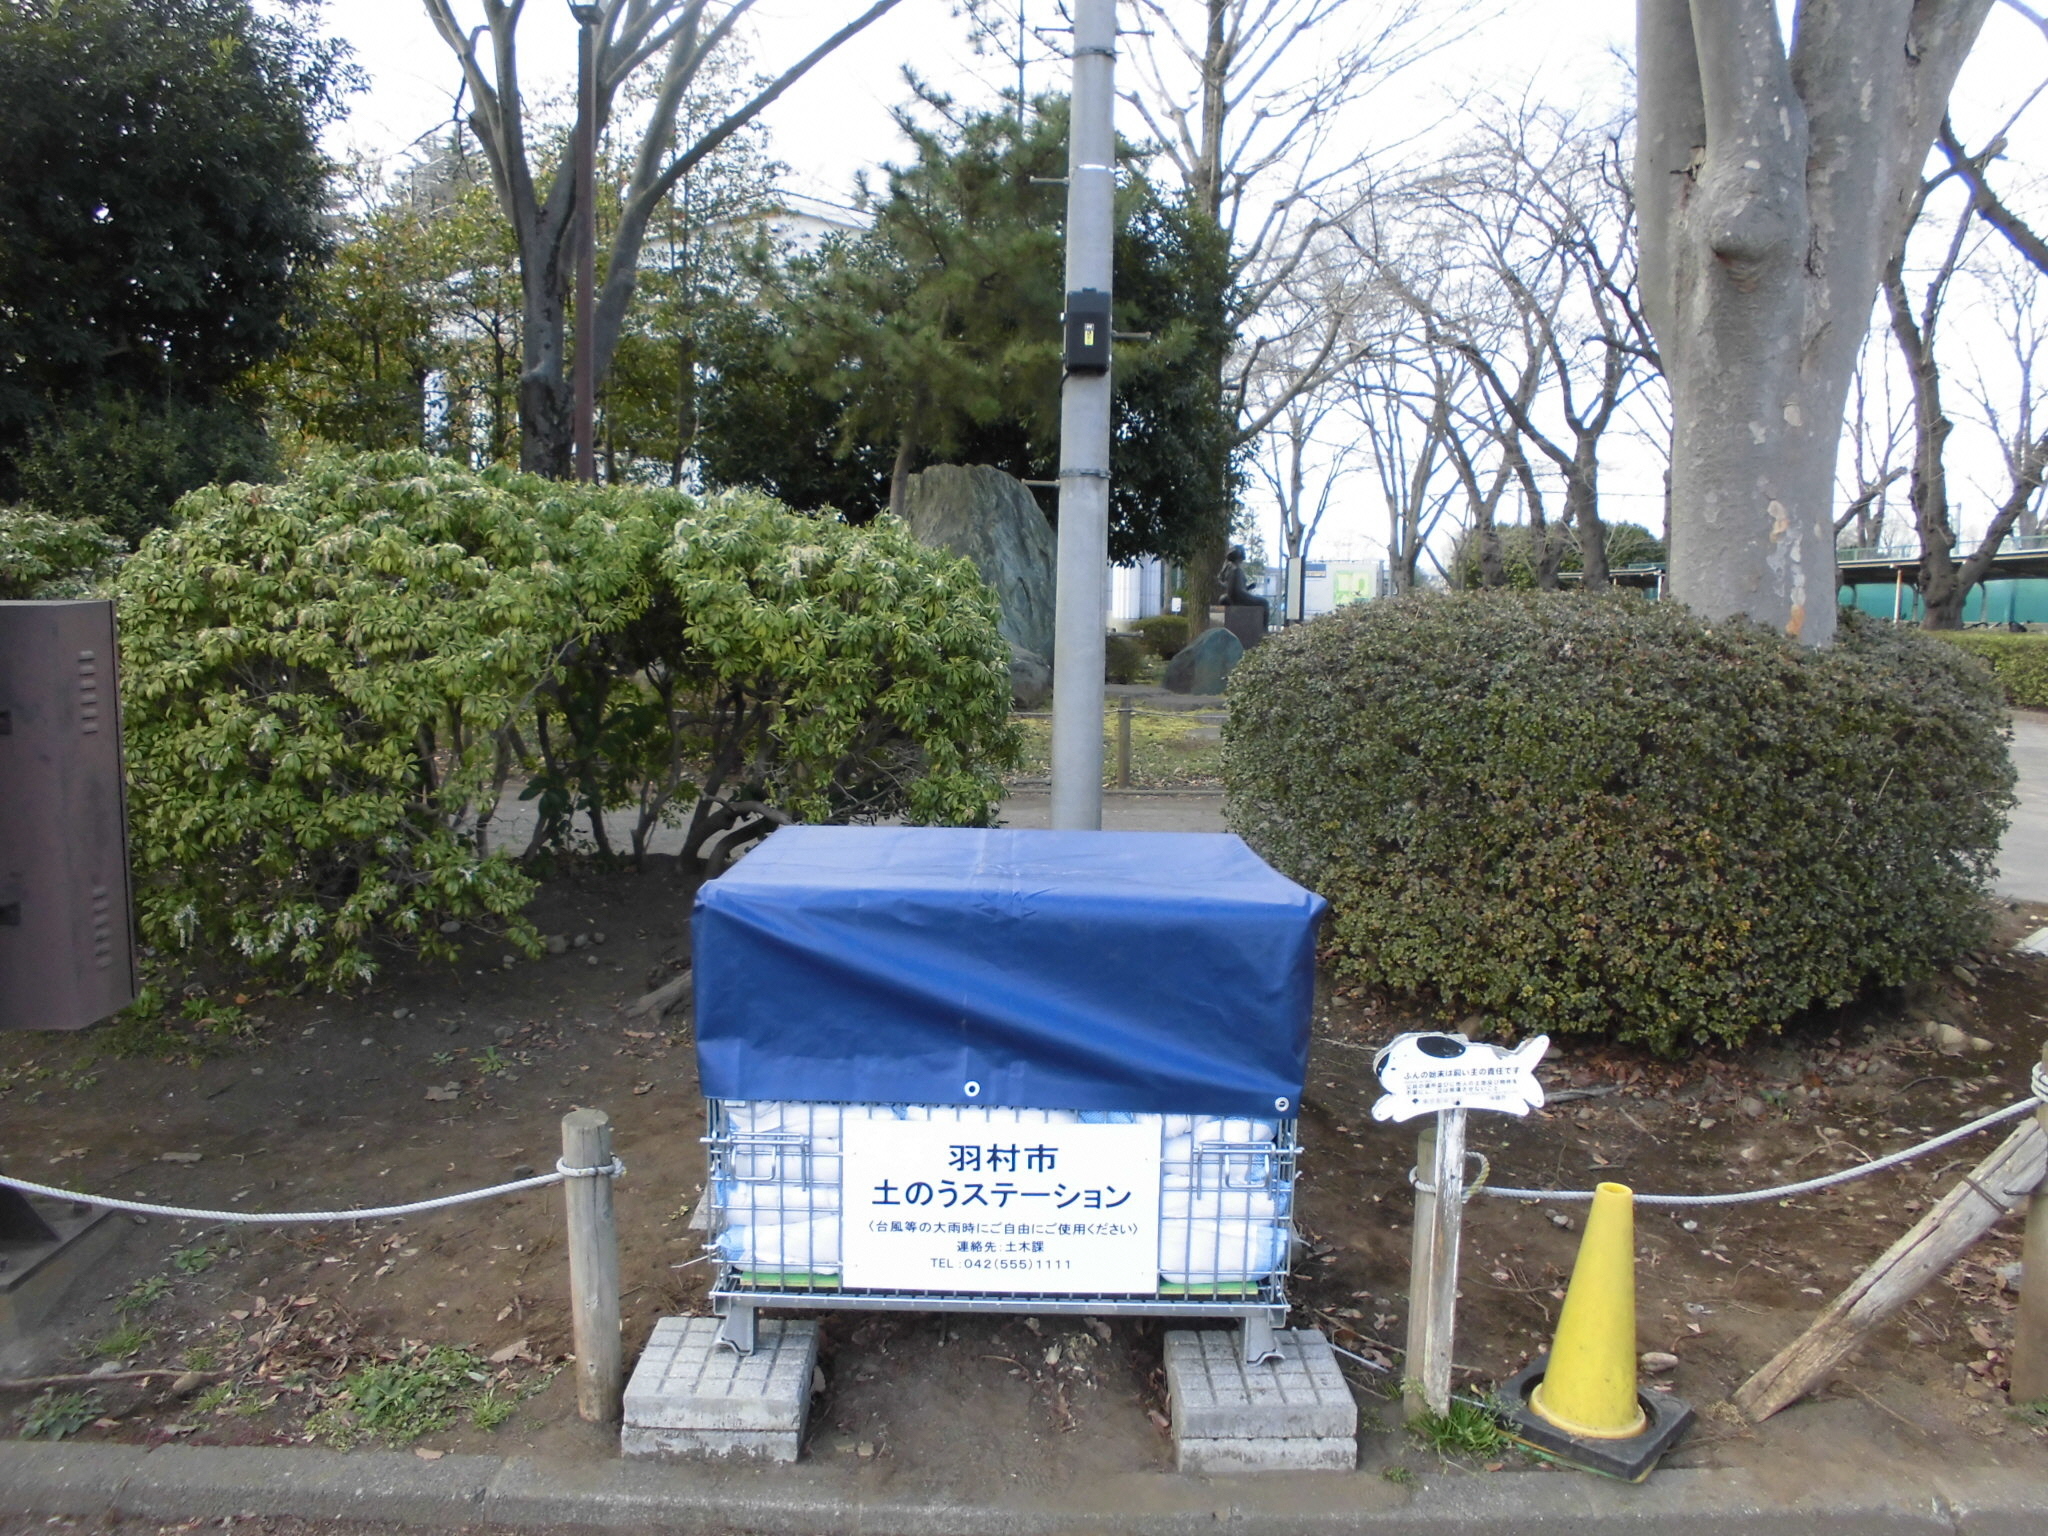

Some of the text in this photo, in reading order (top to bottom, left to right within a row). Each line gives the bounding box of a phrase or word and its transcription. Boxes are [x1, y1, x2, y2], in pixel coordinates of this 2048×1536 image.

[948, 1143, 1059, 1173] 羽村市
[871, 1179, 1132, 1209] 土のうステーション
